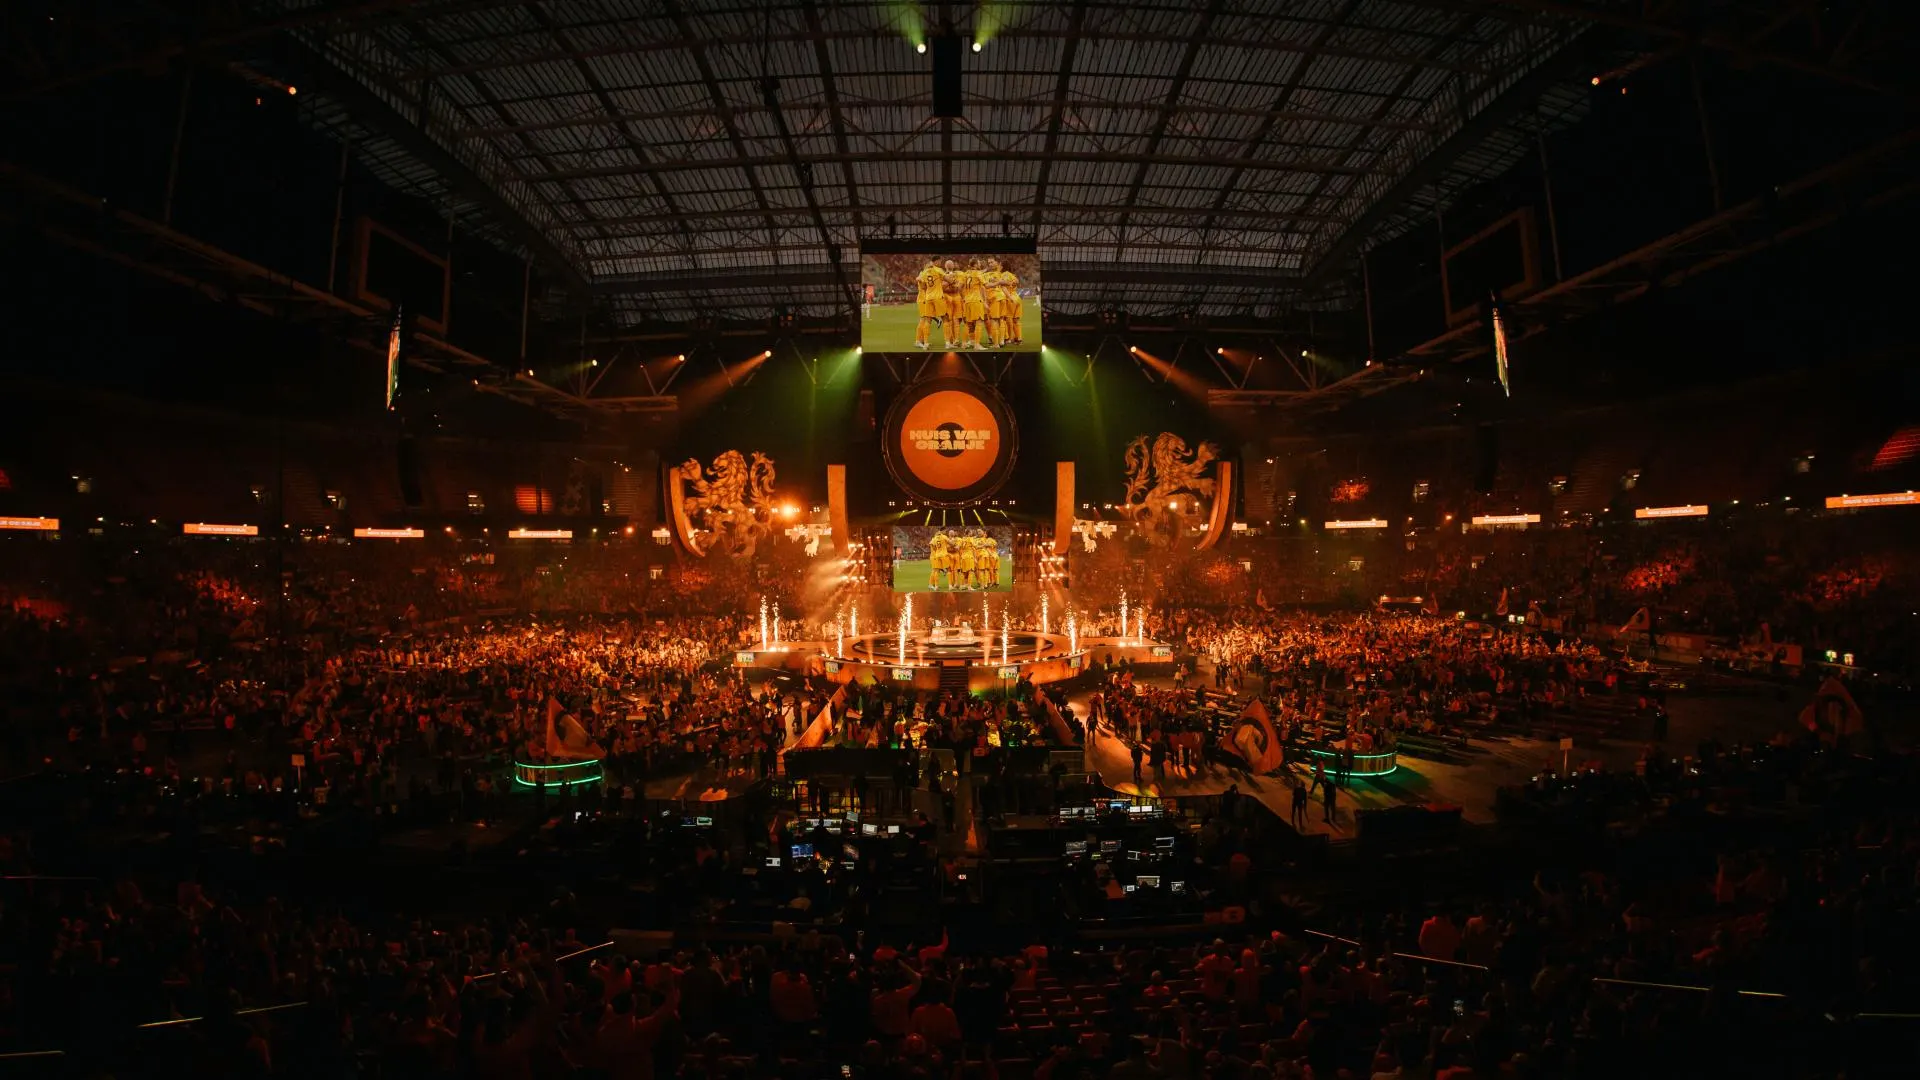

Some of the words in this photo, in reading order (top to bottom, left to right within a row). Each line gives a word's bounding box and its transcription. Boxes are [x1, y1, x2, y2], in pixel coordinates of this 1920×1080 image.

[909, 430, 950, 440] HUIS
[953, 430, 991, 440] VAN
[915, 440, 985, 450] ORANJE
